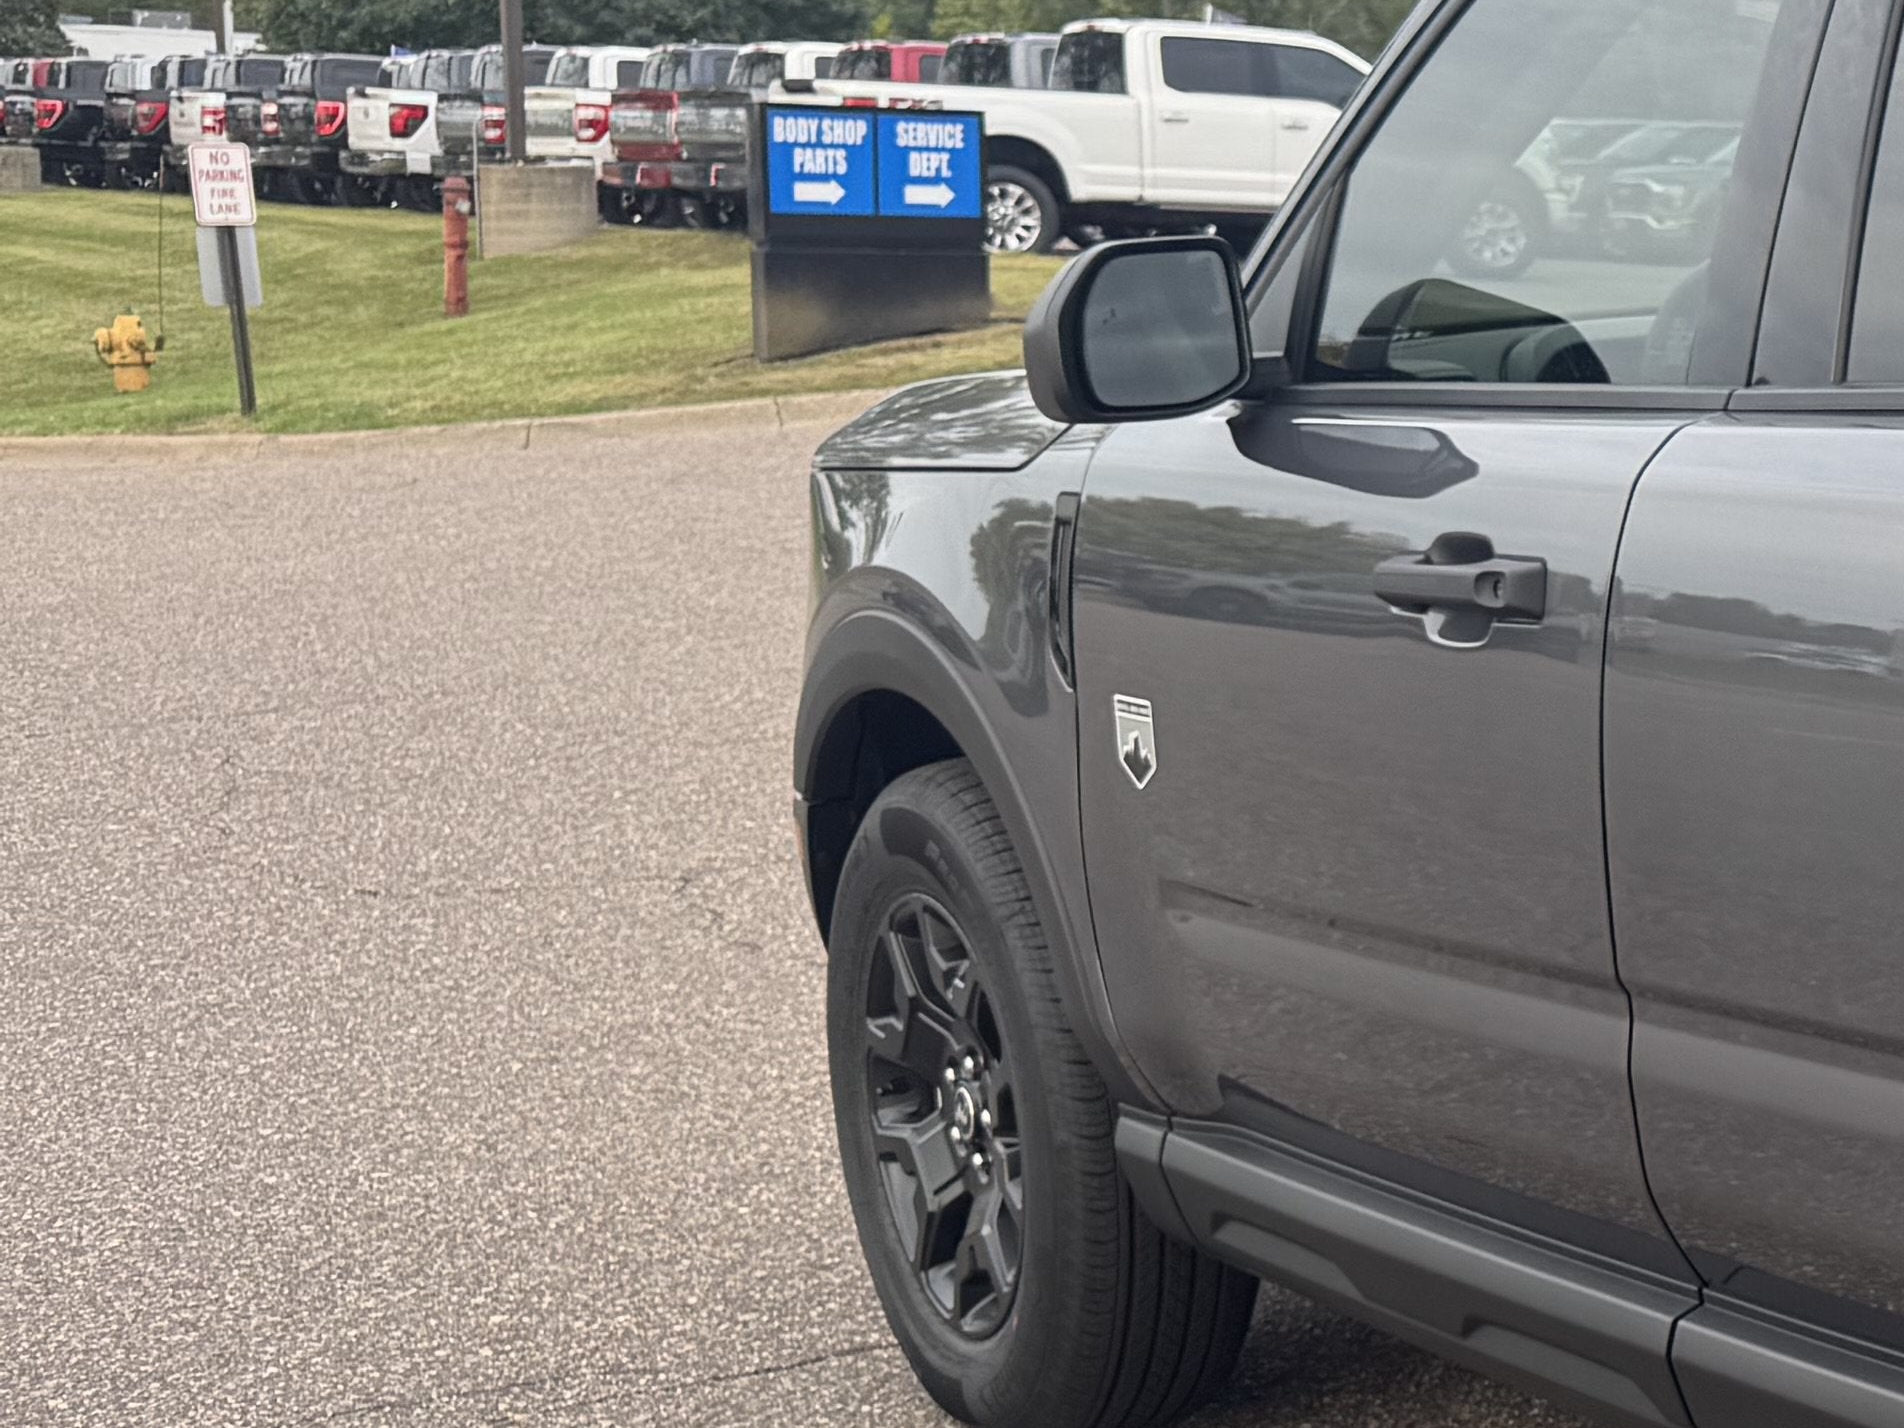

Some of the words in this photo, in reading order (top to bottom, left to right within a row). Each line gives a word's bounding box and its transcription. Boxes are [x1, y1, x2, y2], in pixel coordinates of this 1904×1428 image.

[773, 116, 819, 144] BODY
[821, 119, 868, 146] SHOP
[896, 121, 965, 149] SERVICE
[209, 151, 230, 166] NO
[793, 147, 848, 176] PARTS
[908, 151, 952, 178] DEPT.
[198, 169, 245, 183] PARKING
[210, 186, 236, 200] FIRE
[209, 203, 241, 215] LANE
